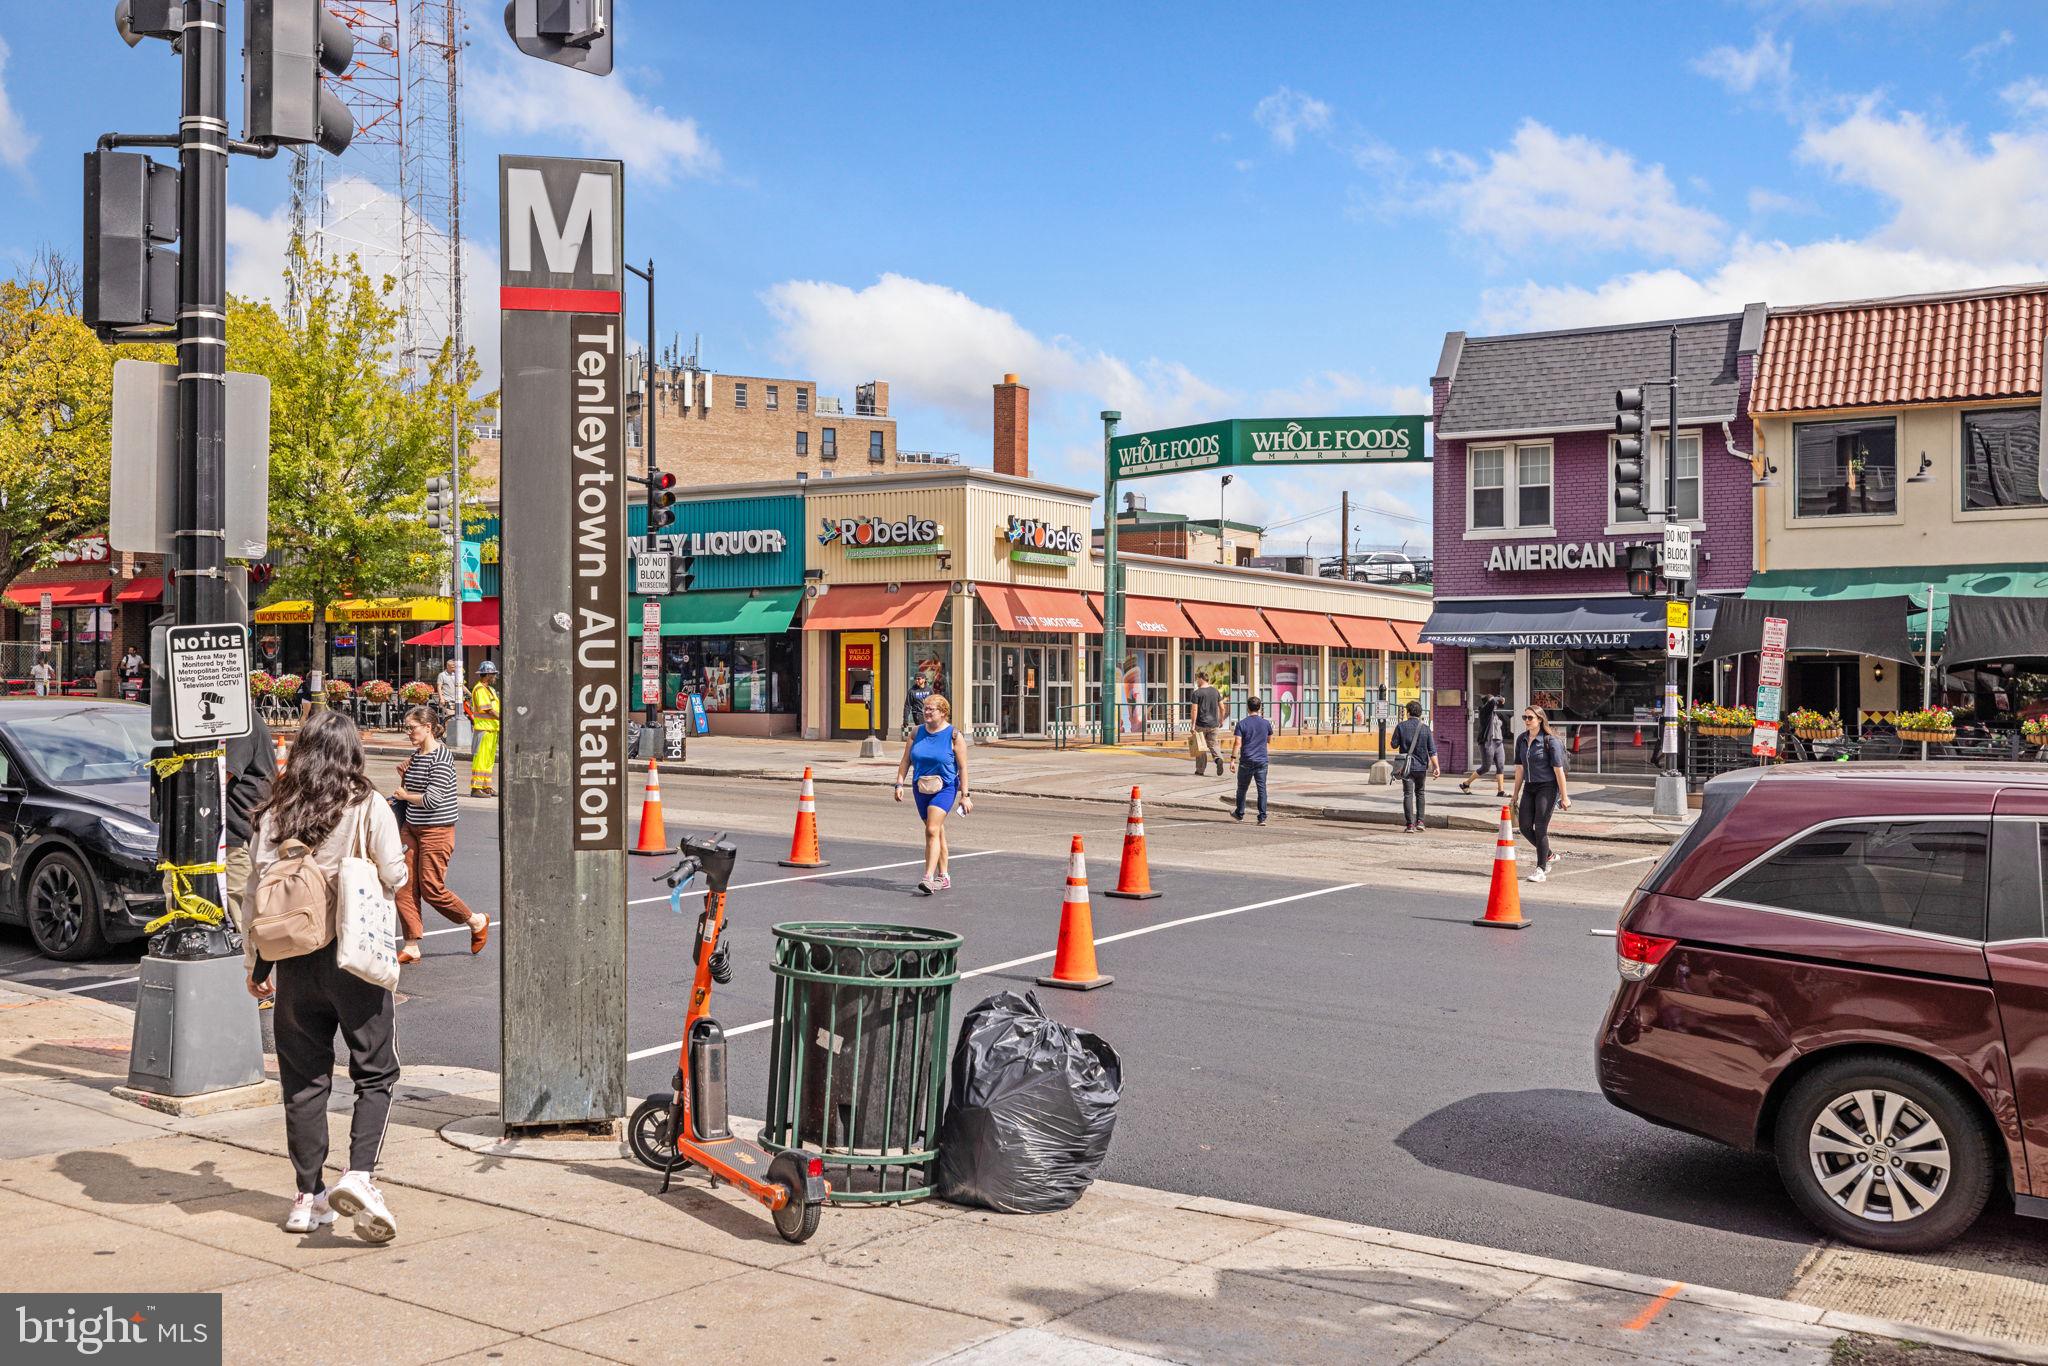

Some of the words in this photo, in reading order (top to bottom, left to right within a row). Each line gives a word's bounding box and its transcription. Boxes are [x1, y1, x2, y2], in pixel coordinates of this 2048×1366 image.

[508, 167, 614, 275] M
[1251, 423, 1332, 451] WHOLE
[1336, 428, 1410, 449] FOODS
[1118, 437, 1169, 467] WHOLE
[1171, 434, 1220, 459] FOODS
[1268, 450, 1395, 459] MARKET
[1128, 457, 1211, 474] MARKET
[841, 515, 936, 545] Robeks
[1024, 520, 1083, 553] Robeks
[1666, 530, 1675, 542] DO
[1677, 531, 1690, 544] NOT
[691, 529, 782, 556] LIQUOR
[1487, 541, 1616, 571] AMERICAN
[1667, 547, 1688, 561] BLOCK
[638, 557, 650, 566] DO
[652, 557, 667, 566] NOT
[1665, 563, 1690, 573] INTERSECTION
[640, 570, 666, 579] BLOCK
[282, 611, 311, 621] KITCHEN
[352, 610, 380, 619] PERSIAN
[1015, 616, 1038, 626] FRUIT
[1038, 616, 1083, 628] SMOOTHIES
[1217, 627, 1244, 637] HEALTHY
[1244, 628, 1260, 638] EATS
[1508, 634, 1583, 645] AMERICAN
[1585, 633, 1631, 645] VALET
[173, 634, 242, 650] NOTICE
[178, 667, 219, 675] Metropolitan
[182, 660, 214, 668] Monitored
[578, 684, 618, 841] Station
